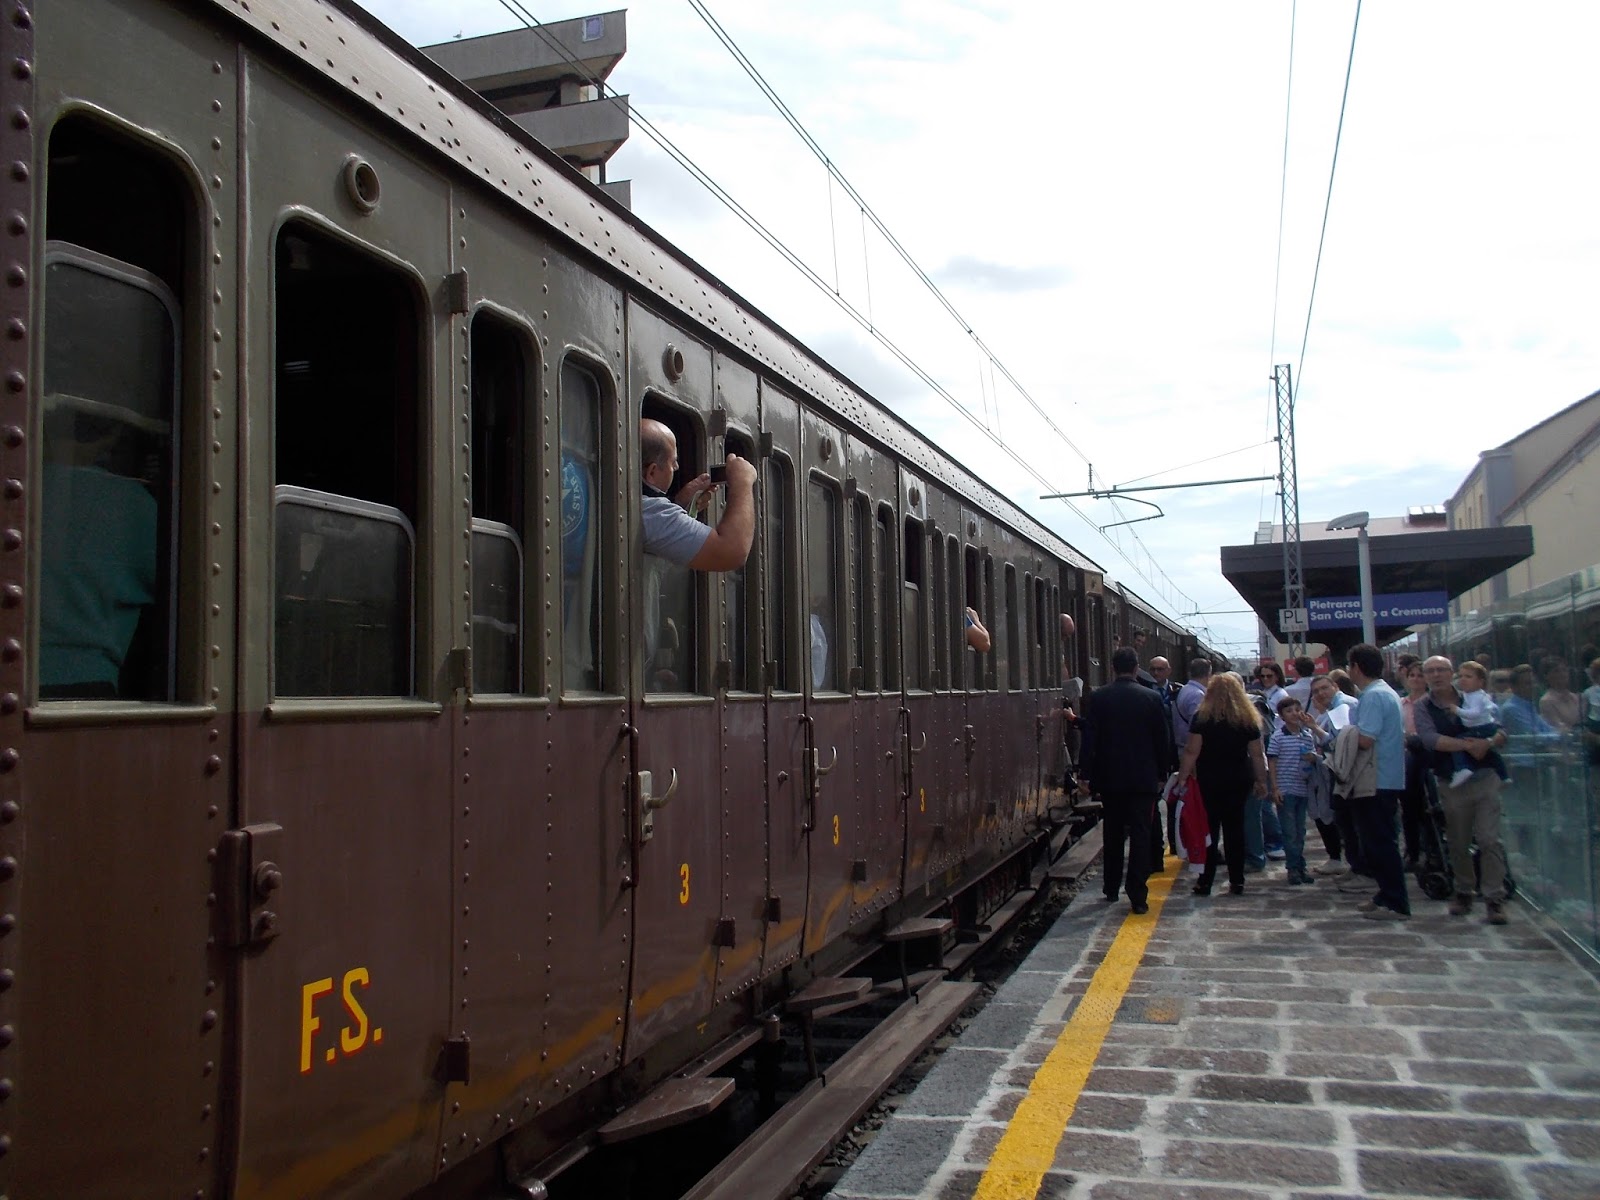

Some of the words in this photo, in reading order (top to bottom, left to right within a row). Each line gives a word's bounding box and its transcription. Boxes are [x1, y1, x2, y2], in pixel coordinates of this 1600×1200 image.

[1284, 610, 1304, 624] PL
[1309, 600, 1361, 610] Pietrarsa
[1310, 611, 1332, 621] San
[1391, 607, 1445, 617] Cremano
[920, 788, 926, 812] 3
[833, 814, 840, 845] 3
[679, 863, 690, 905] 3
[300, 966, 384, 1074] F.S.
